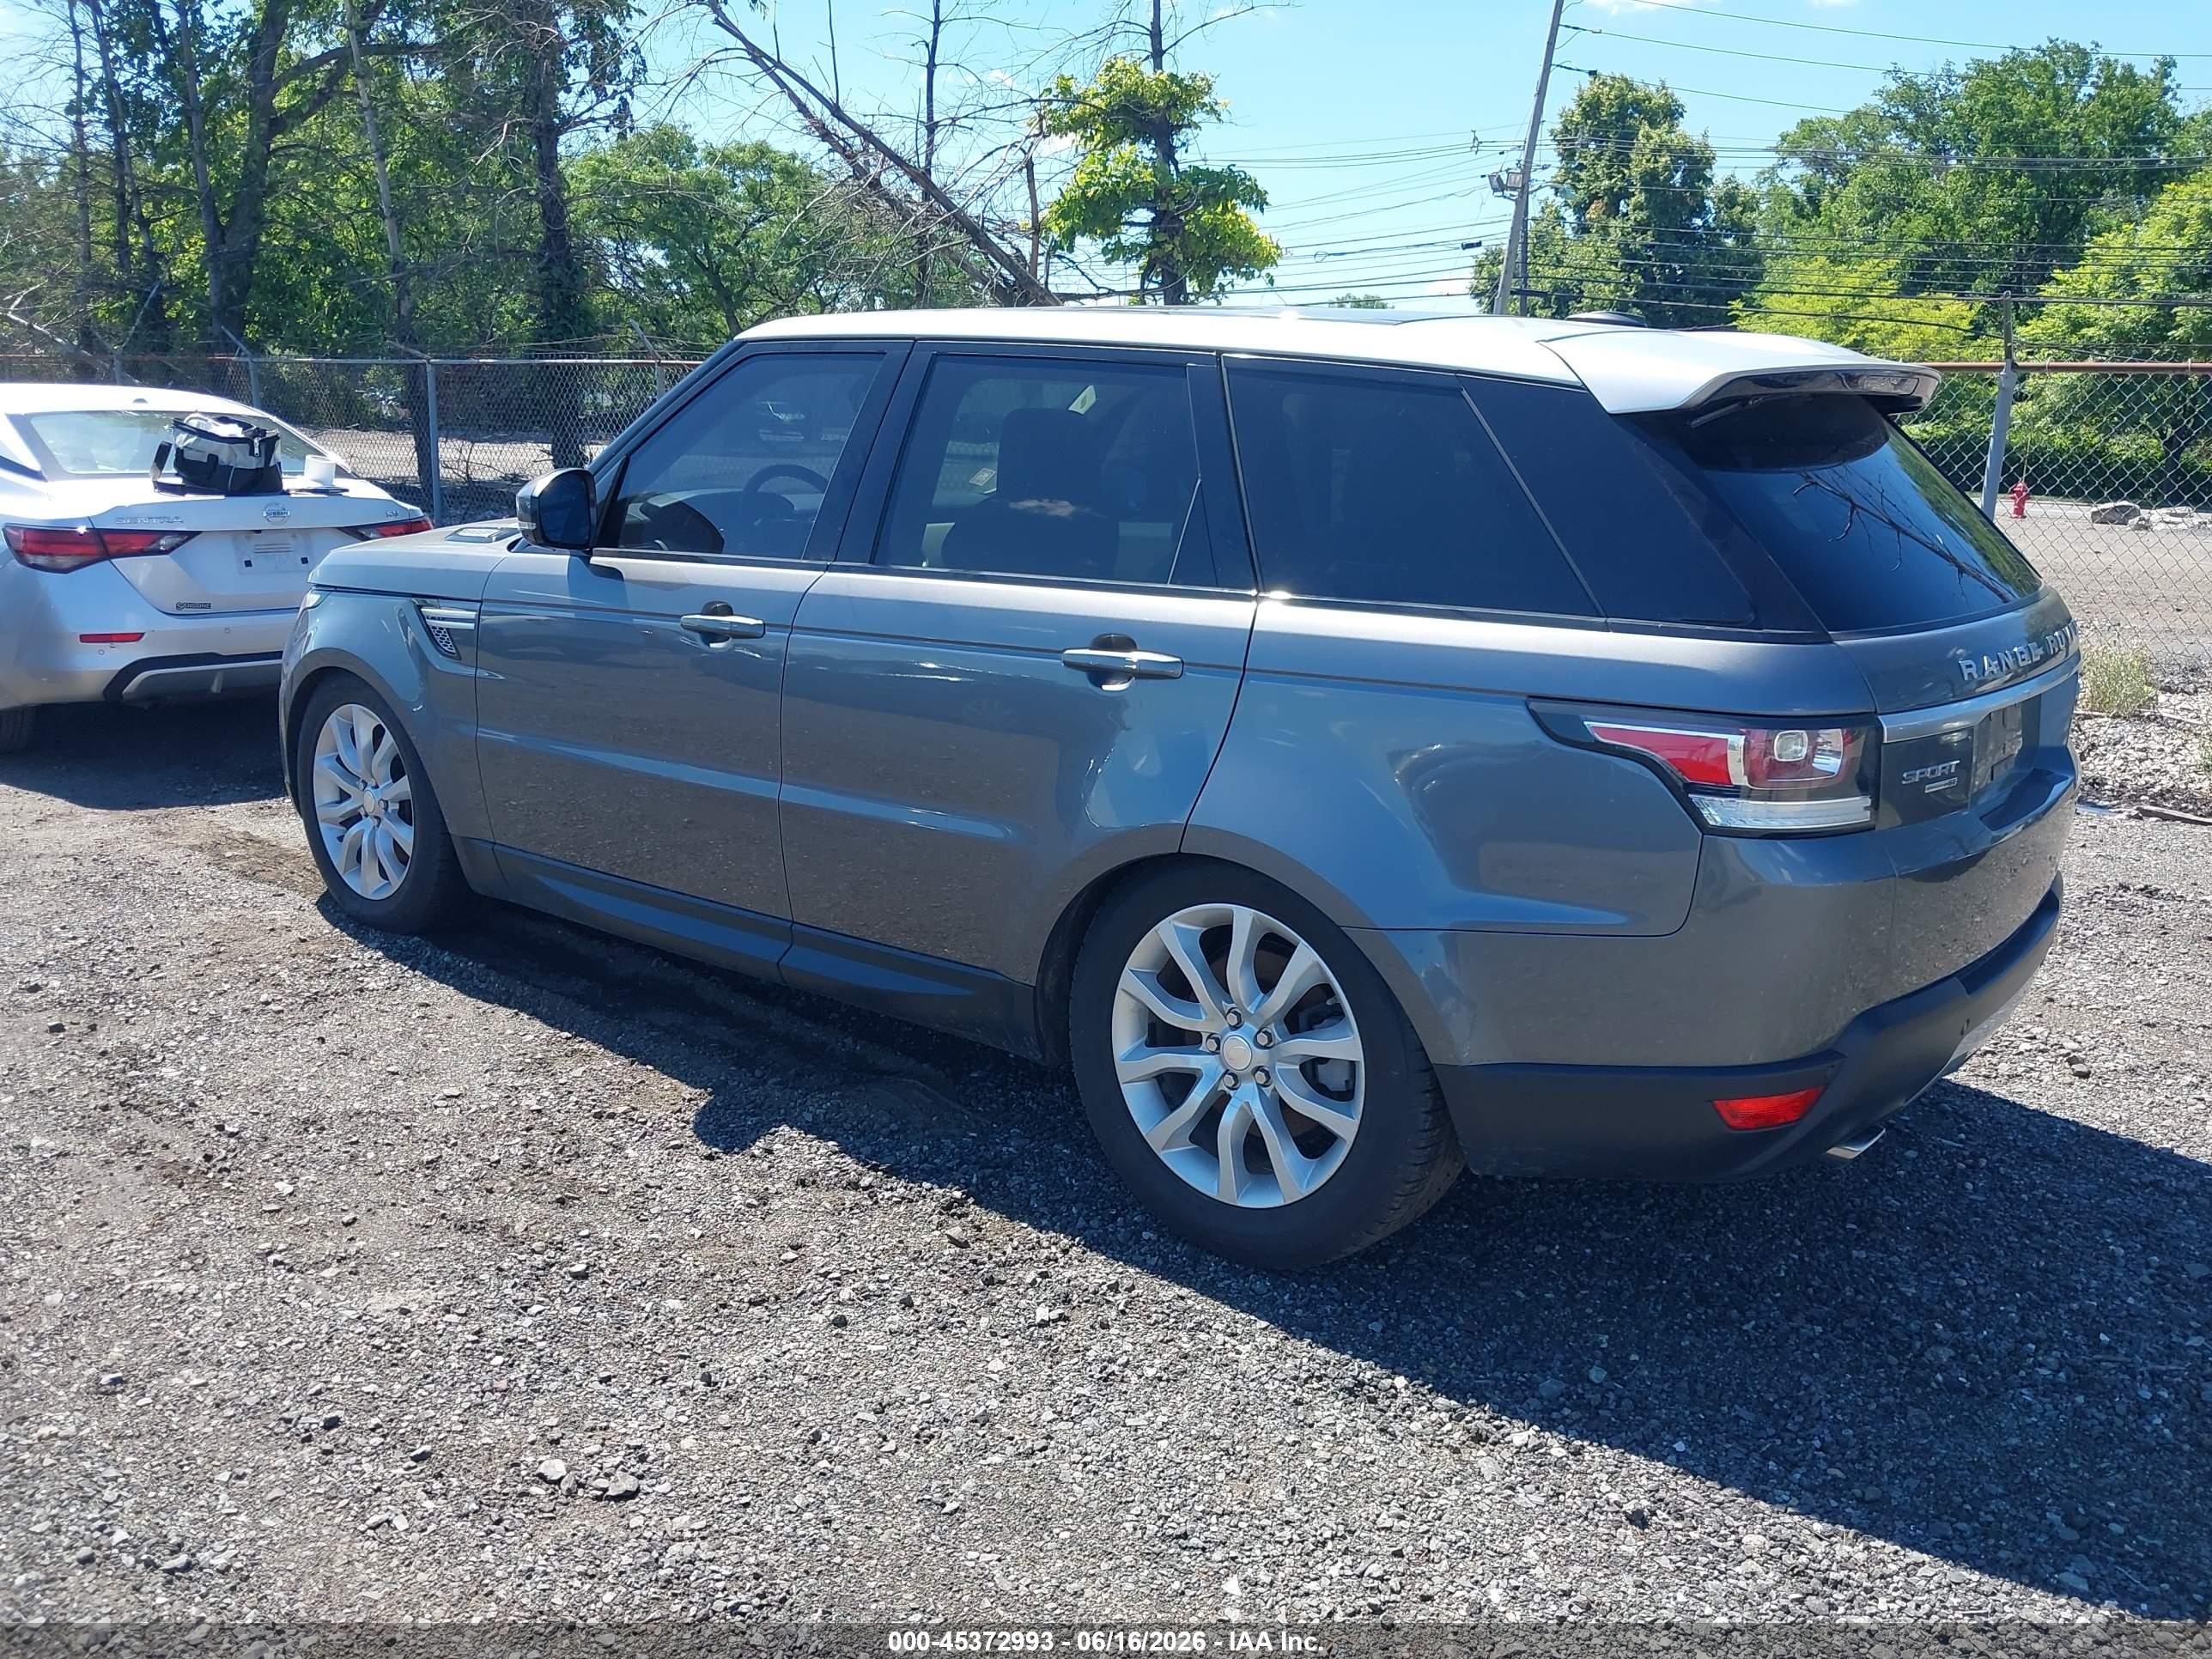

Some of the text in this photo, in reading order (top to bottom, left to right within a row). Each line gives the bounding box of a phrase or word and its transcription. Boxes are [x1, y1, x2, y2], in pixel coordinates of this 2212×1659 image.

[116, 516, 184, 525] SENTRA
[1959, 641, 2043, 681] RANGE
[1902, 760, 1960, 784] SPORT
